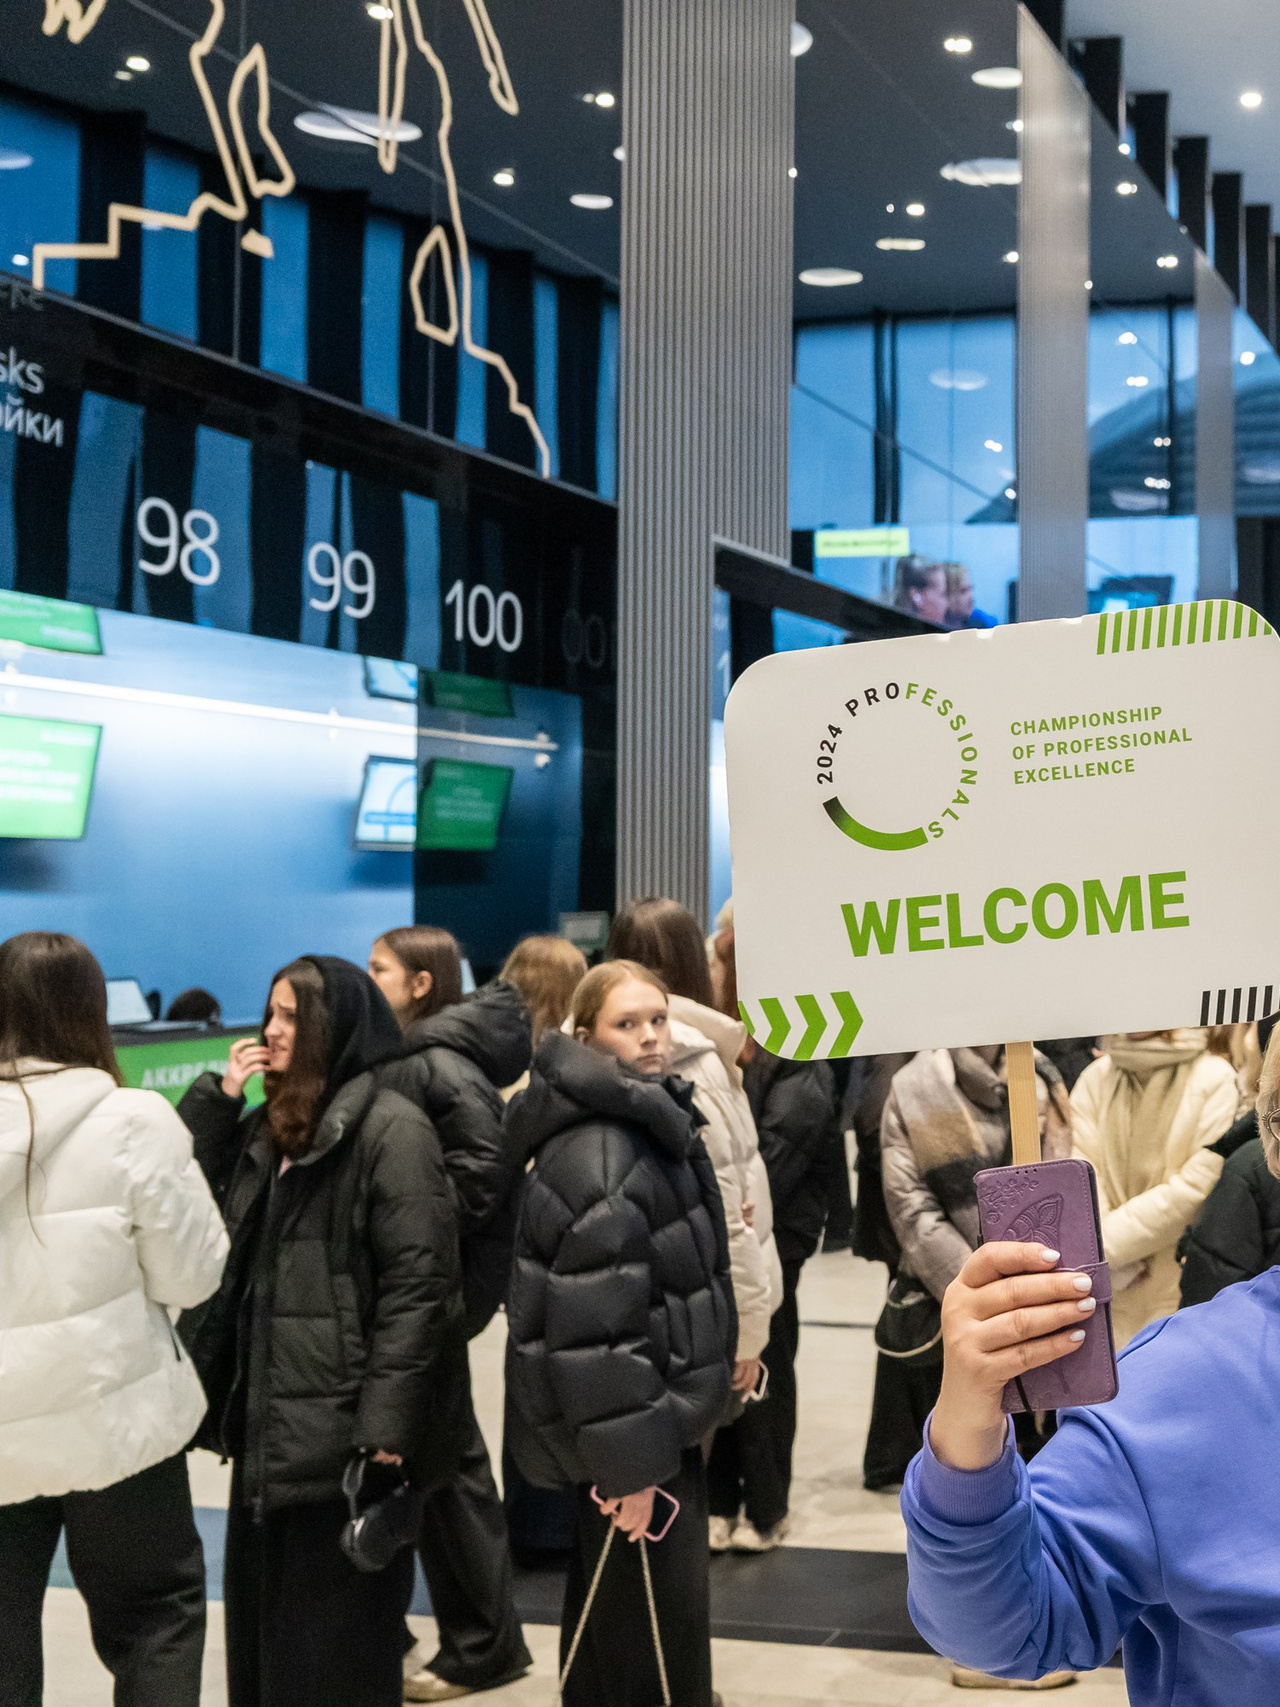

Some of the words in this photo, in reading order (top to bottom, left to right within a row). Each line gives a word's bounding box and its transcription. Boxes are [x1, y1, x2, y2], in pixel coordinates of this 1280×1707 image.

[0, 392, 64, 447] йки
[136, 496, 221, 587] 98
[307, 541, 376, 619] 99
[445, 578, 523, 653] 100
[1010, 705, 1162, 736] CHAMPIONSHIP
[1012, 744, 1036, 760] OF
[1044, 727, 1193, 757] PROFESSIONAL
[816, 723, 843, 785] 2024
[844, 682, 979, 839] PROFESSIONALS
[1013, 758, 1135, 785] EXCELLENCE
[840, 870, 1191, 958] WELCOME
